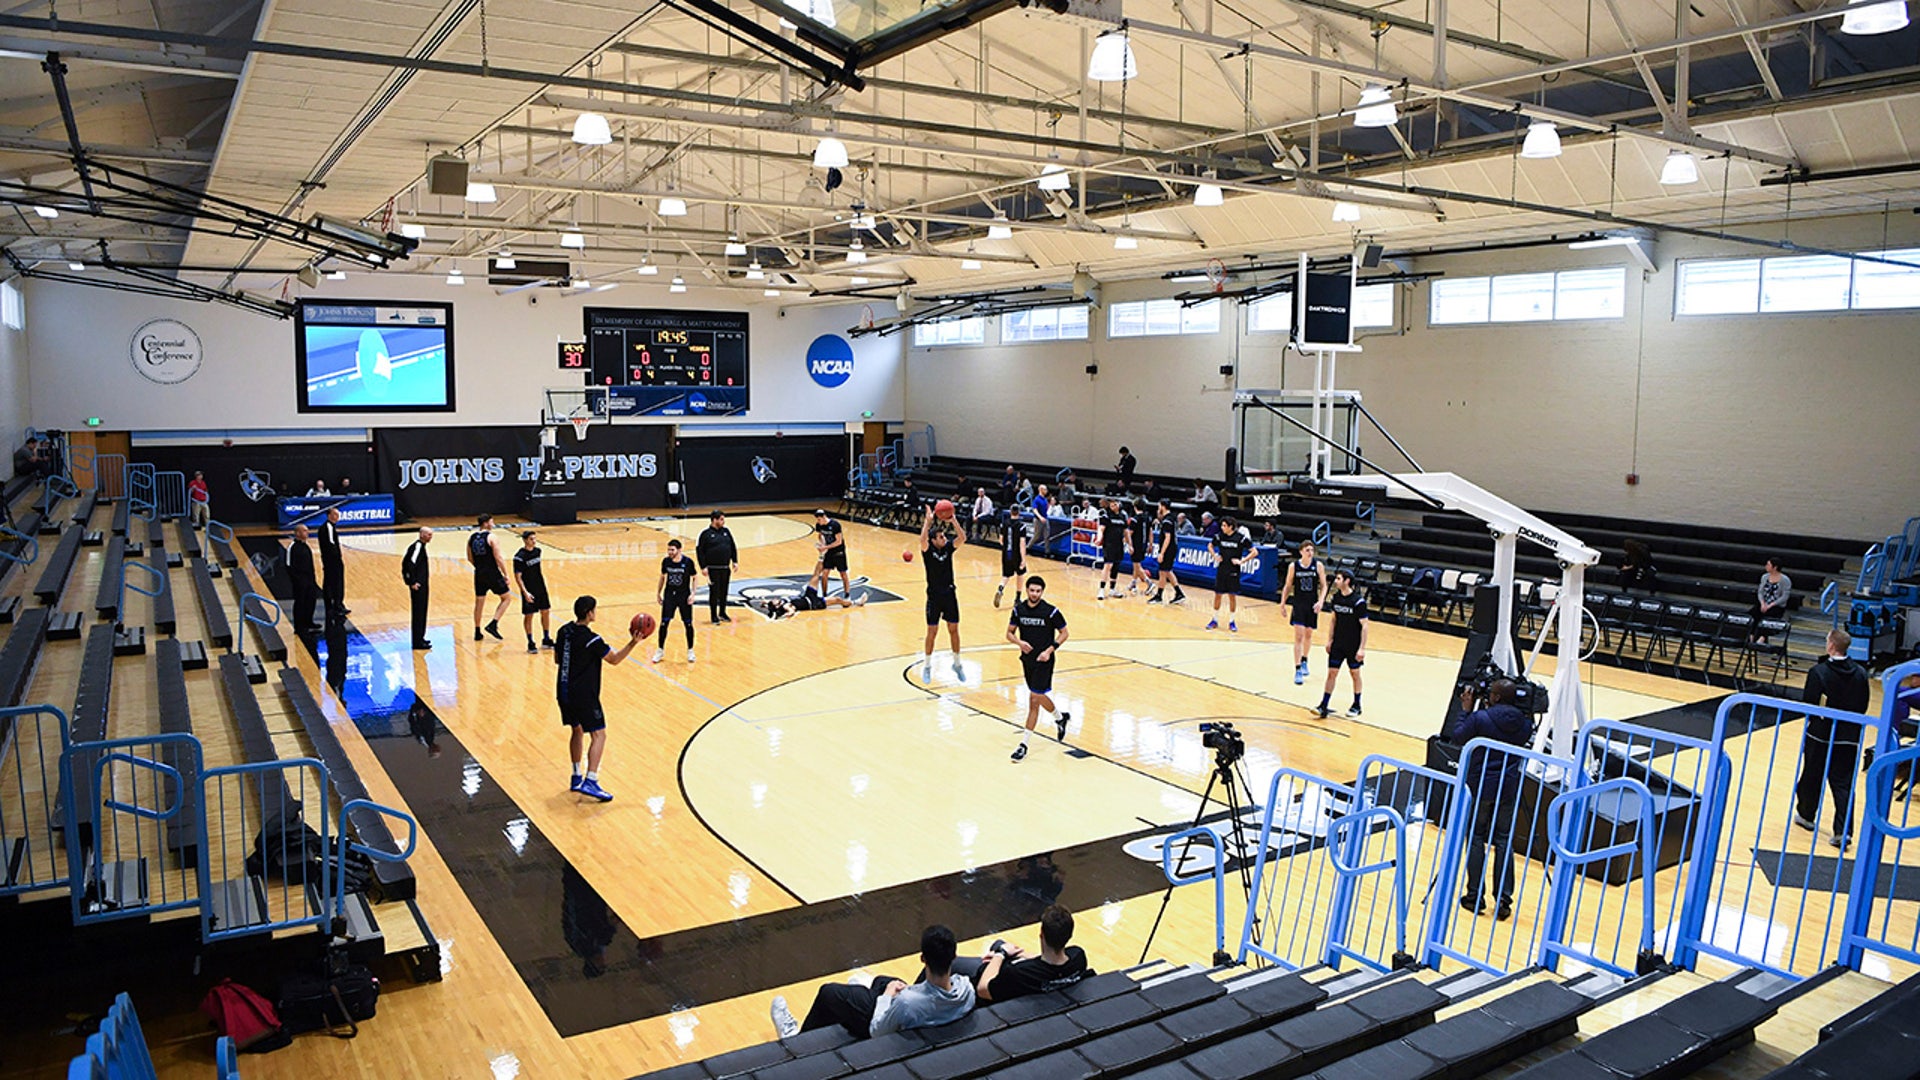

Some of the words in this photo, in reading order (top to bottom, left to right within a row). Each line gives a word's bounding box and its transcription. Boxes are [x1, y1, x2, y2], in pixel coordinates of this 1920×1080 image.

[141, 335, 185, 353] Centennial
[146, 347, 193, 366] Conference
[565, 352, 582, 367] 30
[641, 351, 650, 365] 0
[701, 353, 710, 366] 0
[811, 360, 853, 374] NCAA
[633, 369, 642, 380] 0
[702, 370, 710, 380] 0
[398, 457, 505, 489] JOHNS
[517, 454, 657, 481] HPKINS
